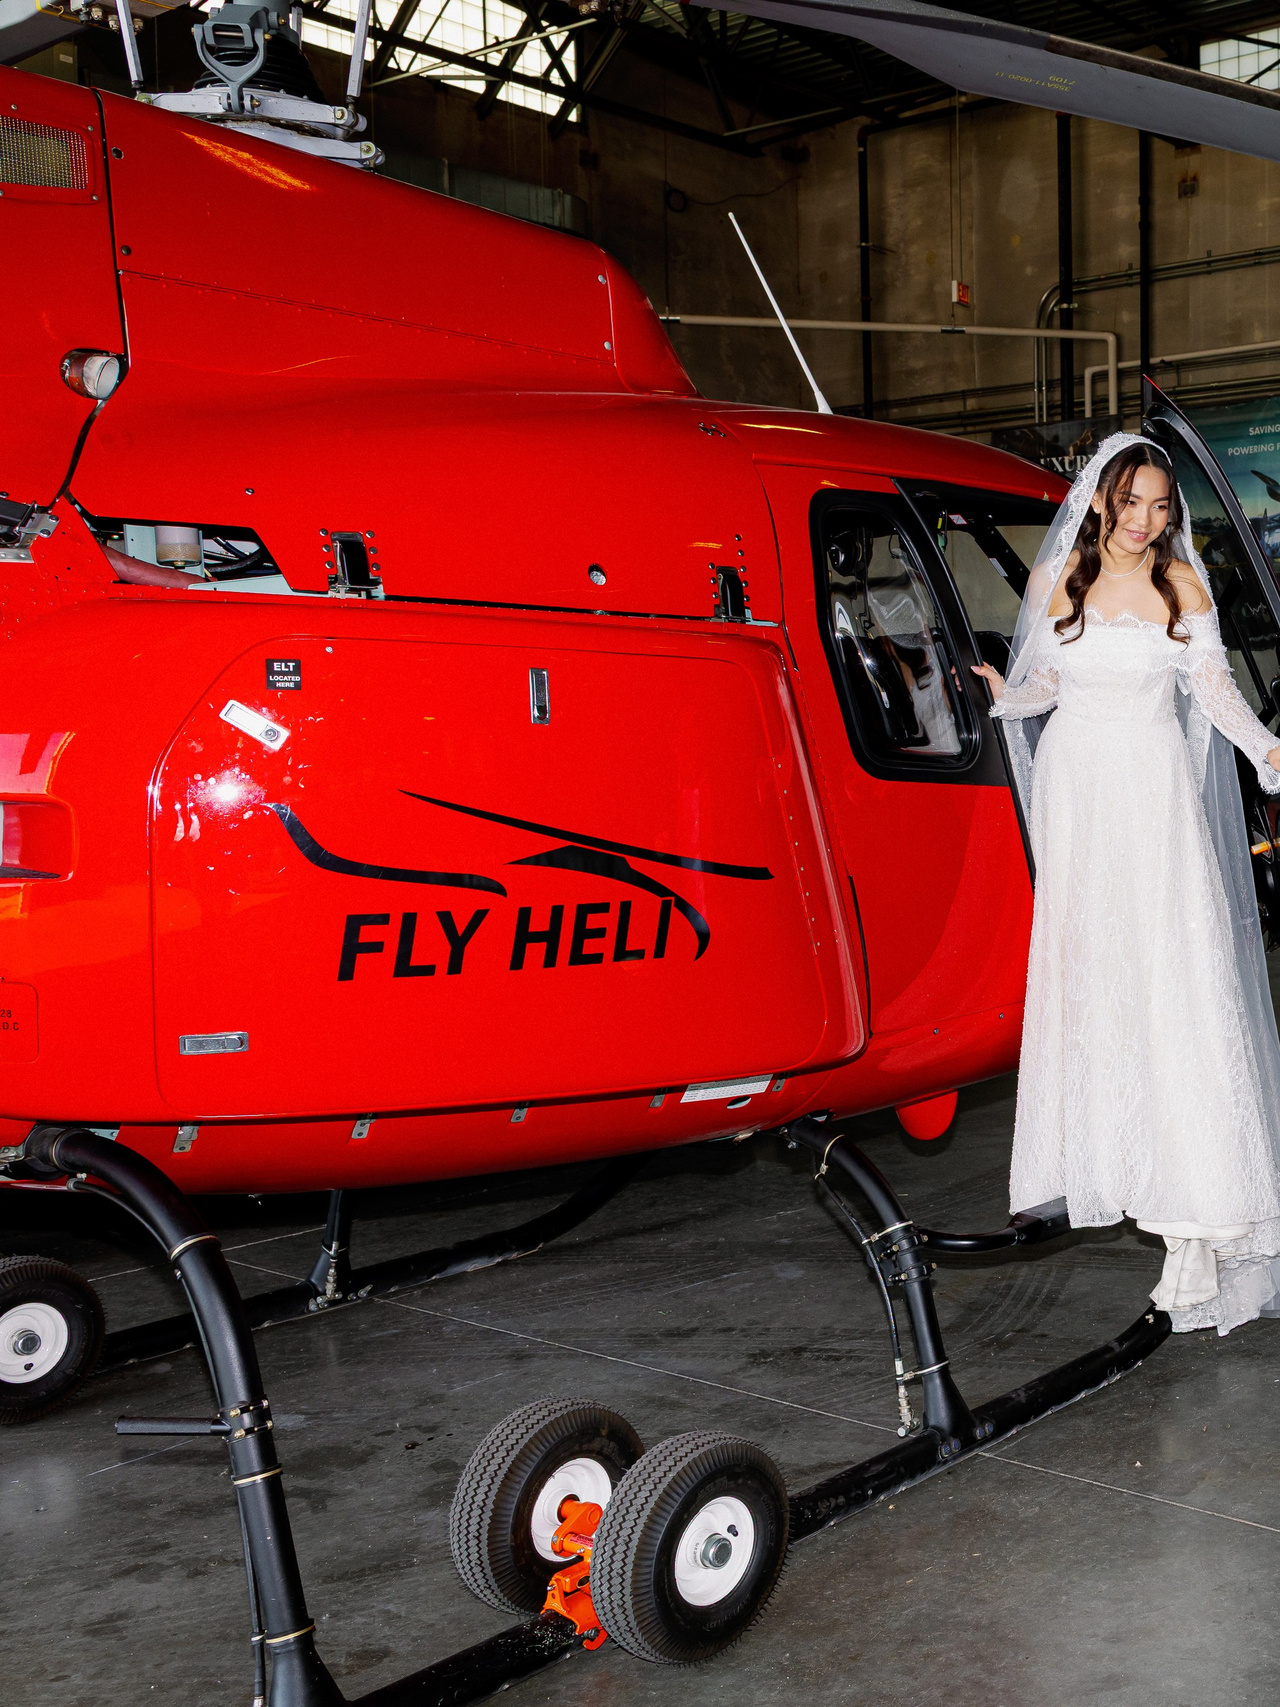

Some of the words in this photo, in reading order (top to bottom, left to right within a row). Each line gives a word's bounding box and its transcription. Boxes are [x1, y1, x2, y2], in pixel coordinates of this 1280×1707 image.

[1248, 424, 1280, 436] SAVING
[1227, 443, 1275, 456] POWERING
[273, 662, 296, 671] ELT
[509, 896, 676, 972] HELI
[337, 908, 491, 982] FLY
